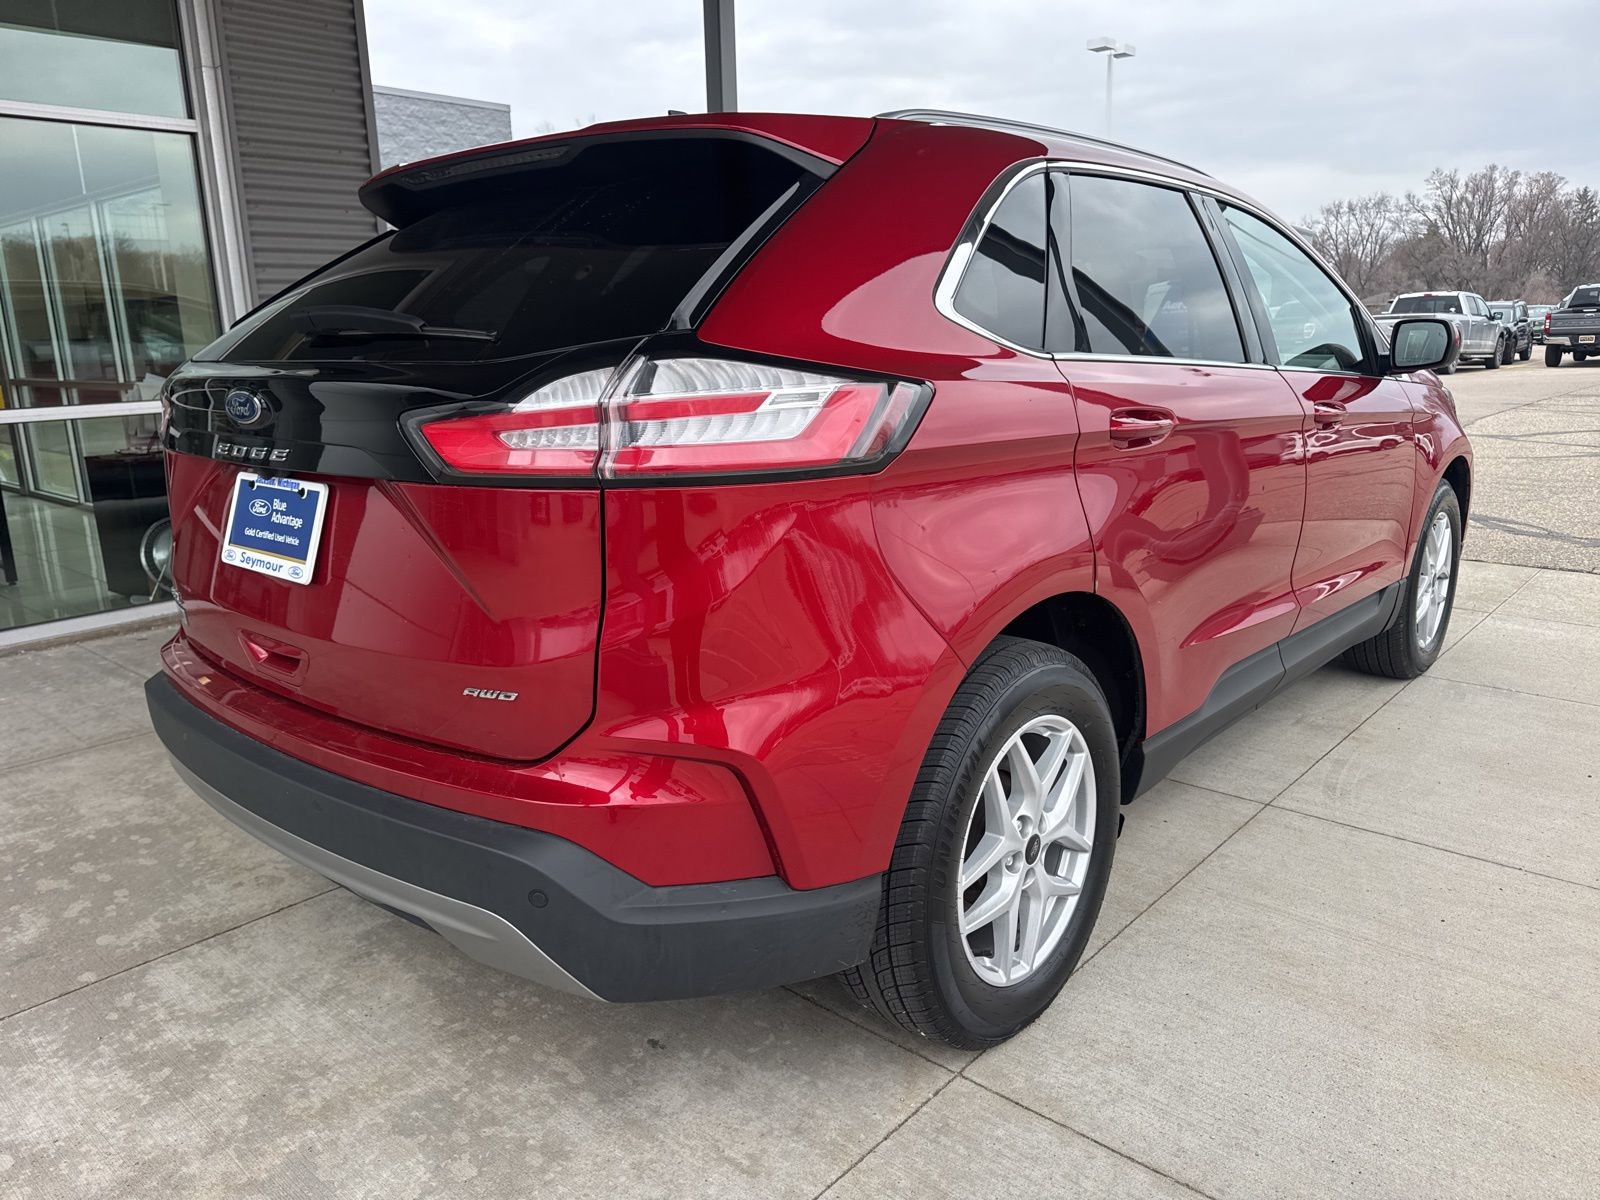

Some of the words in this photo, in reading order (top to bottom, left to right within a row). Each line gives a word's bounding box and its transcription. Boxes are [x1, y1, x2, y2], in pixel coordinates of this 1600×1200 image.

[228, 397, 250, 417] Ford
[216, 442, 290, 462] EDGE
[252, 501, 268, 514] Ford
[273, 498, 287, 511] Blue
[270, 511, 303, 530] Advantage
[244, 527, 256, 537] Gold
[255, 529, 275, 541] Certified
[274, 532, 286, 543] Used
[285, 535, 300, 546] Vehicle
[240, 551, 283, 573] Seymour
[463, 687, 519, 701] AWD
